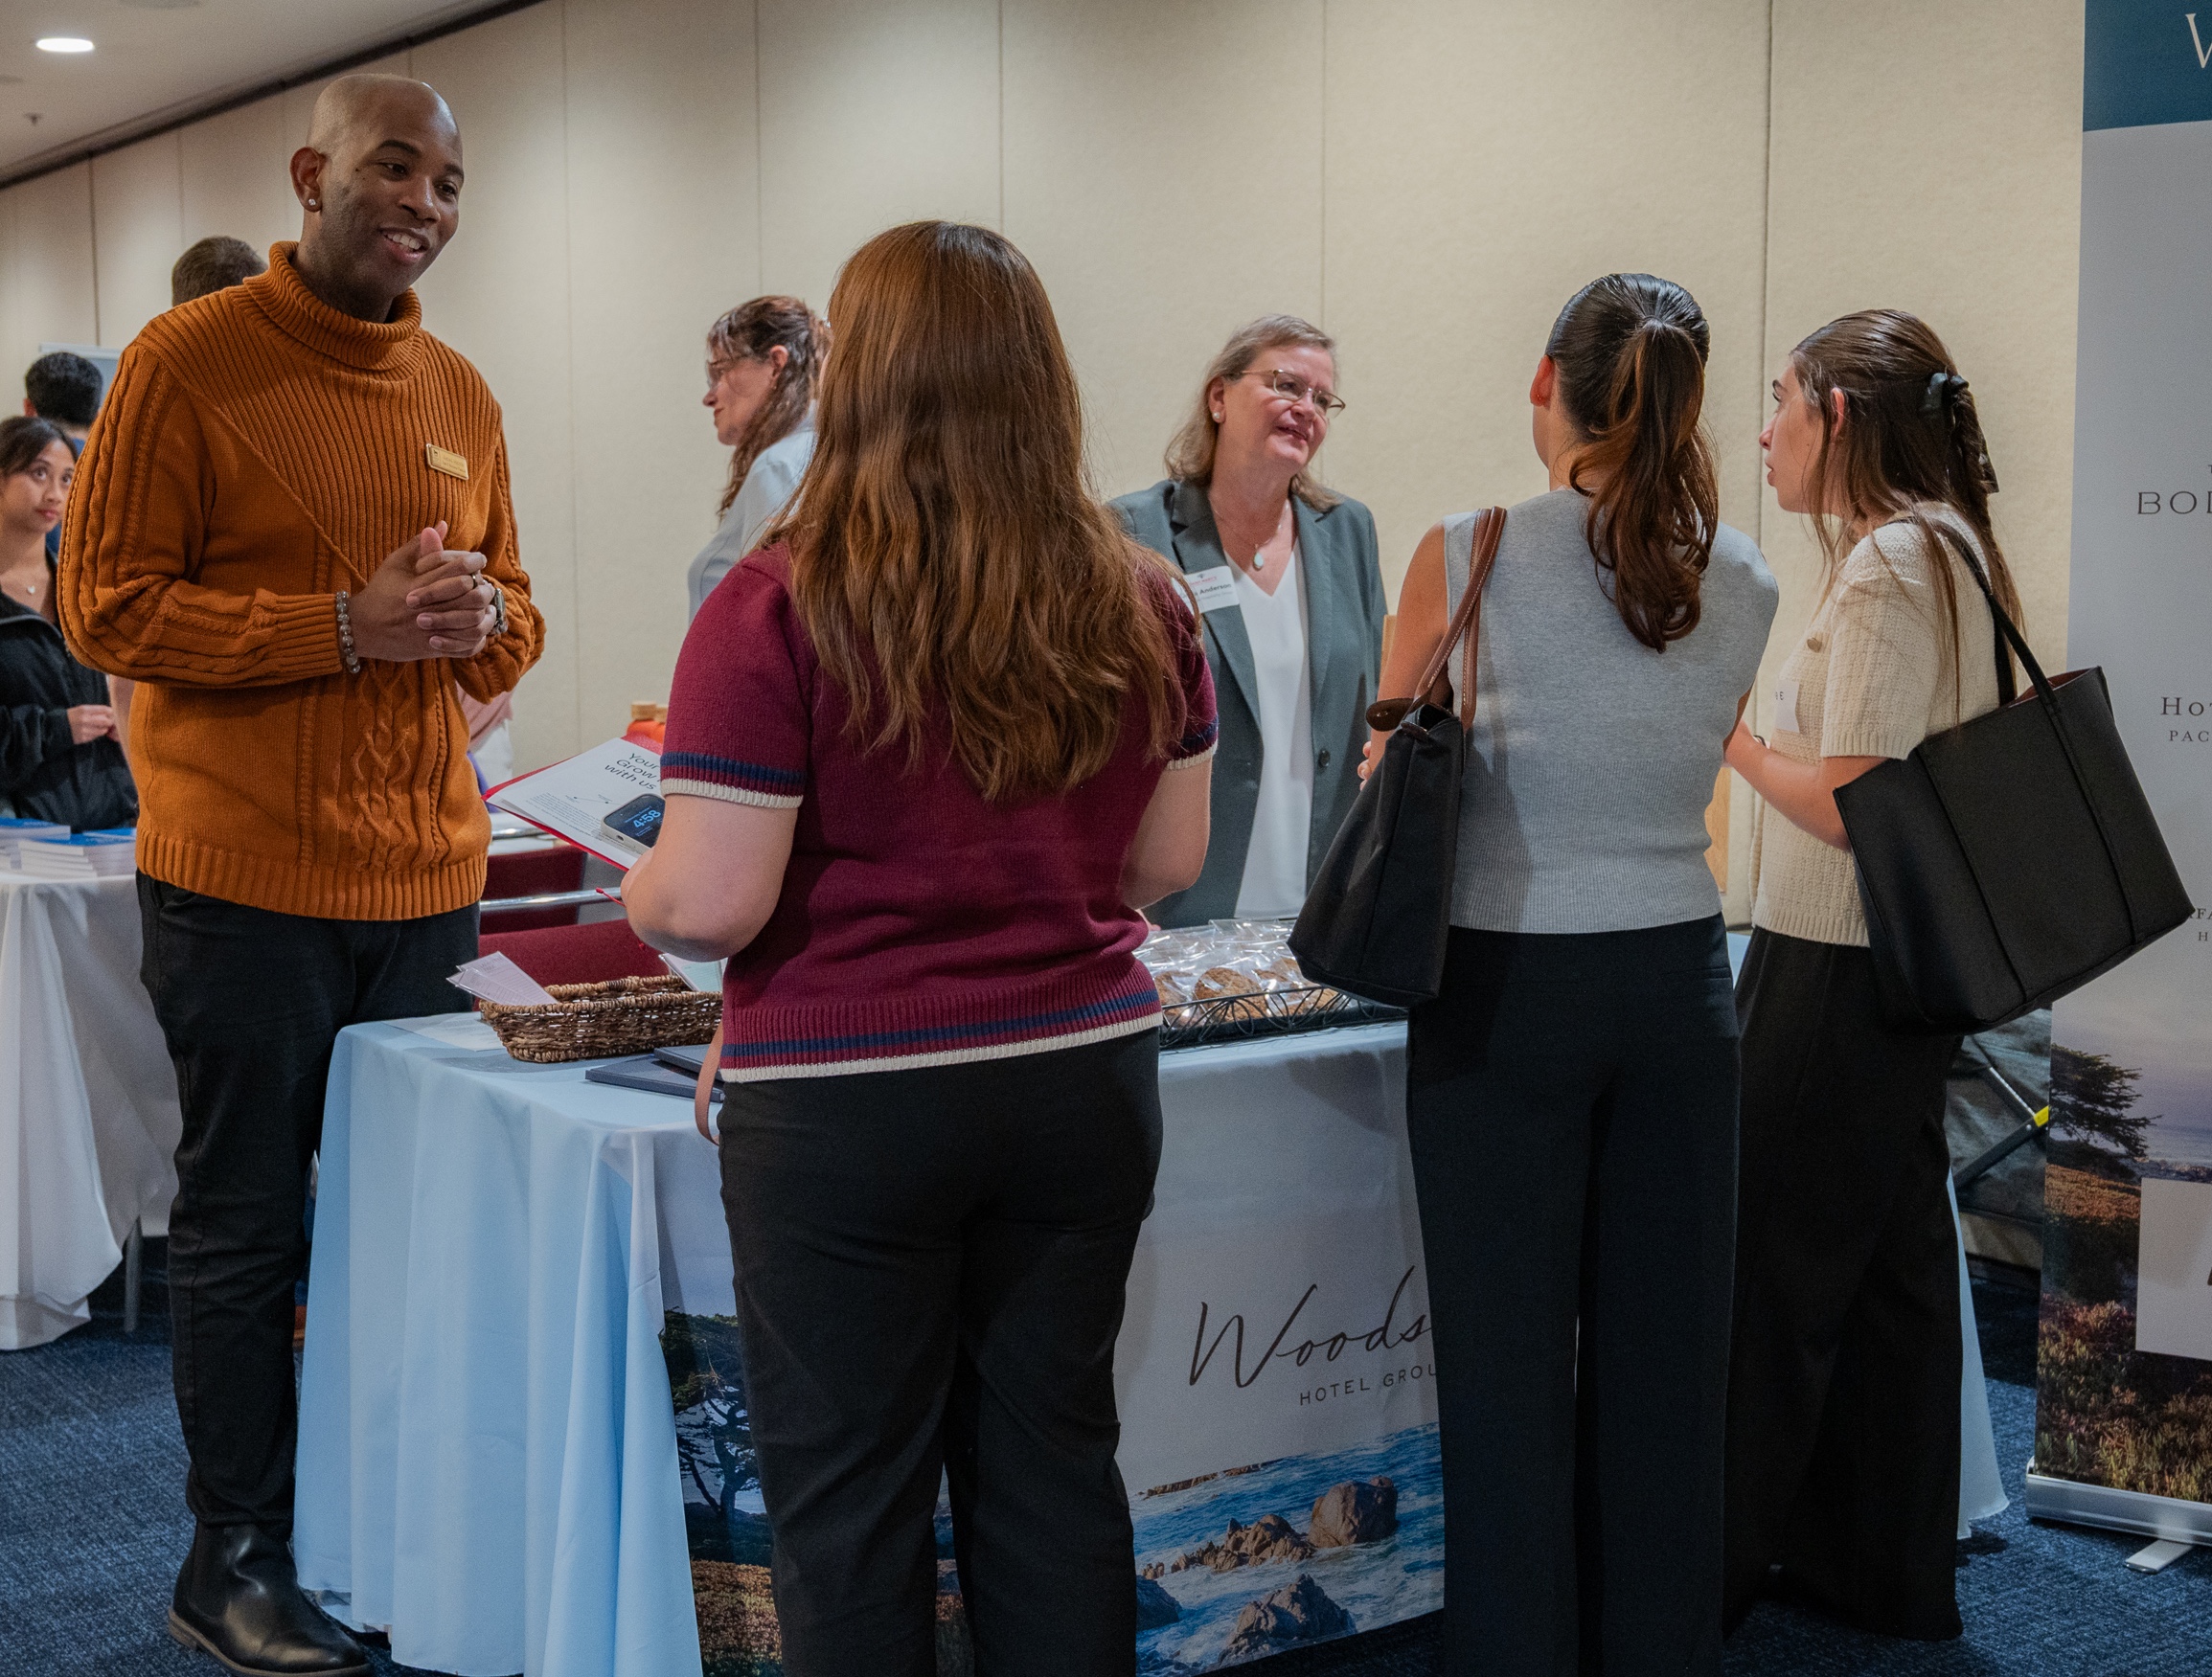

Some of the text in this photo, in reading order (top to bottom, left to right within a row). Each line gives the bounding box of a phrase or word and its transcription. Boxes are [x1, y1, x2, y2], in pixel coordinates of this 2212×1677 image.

[1199, 583, 1232, 594] Anderson
[616, 759, 657, 779] Grow
[629, 753, 660, 769] Your
[604, 765, 657, 790] with us
[633, 809, 661, 828] 4:58
[1300, 1377, 1371, 1406] HOTEL
